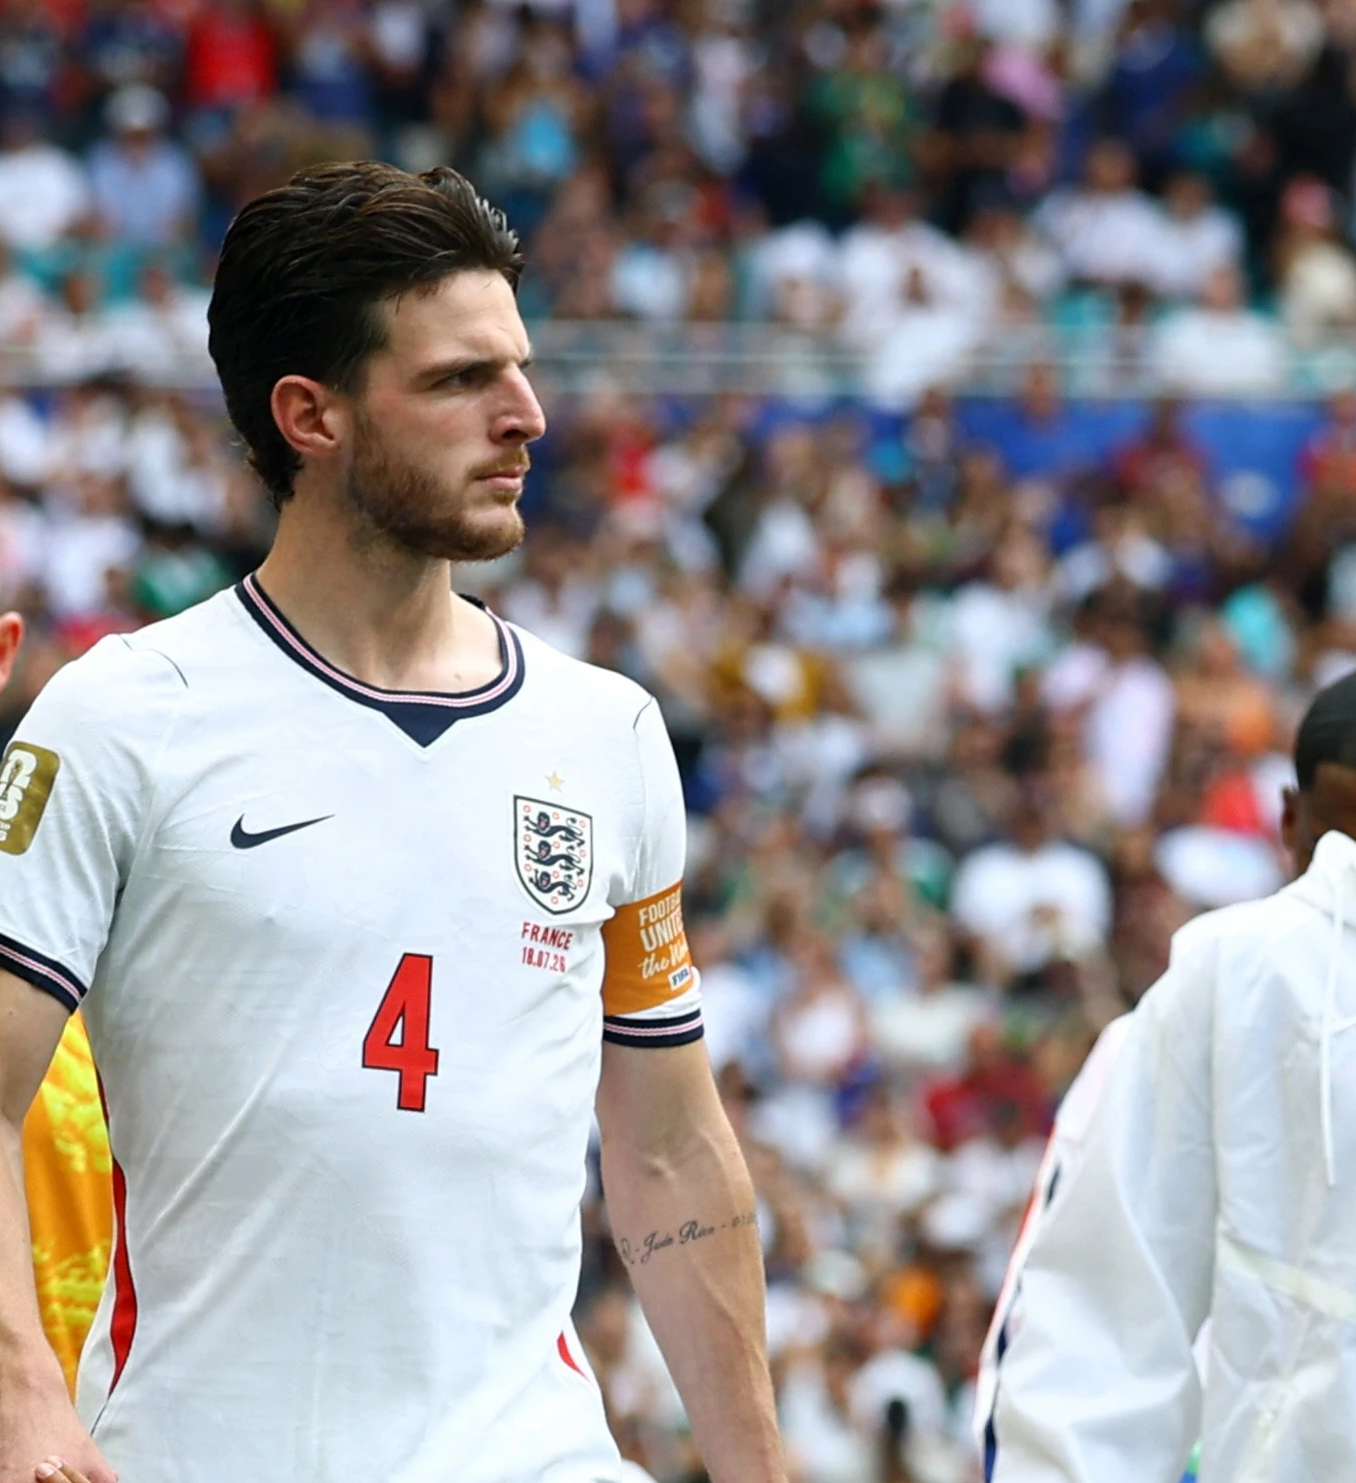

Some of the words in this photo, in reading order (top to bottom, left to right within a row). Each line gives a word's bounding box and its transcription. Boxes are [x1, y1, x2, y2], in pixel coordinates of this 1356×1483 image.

[521, 921, 574, 951] FRANCE
[522, 946, 566, 973] 18.07.26
[638, 952, 670, 980] the
[362, 952, 440, 1113] 4
